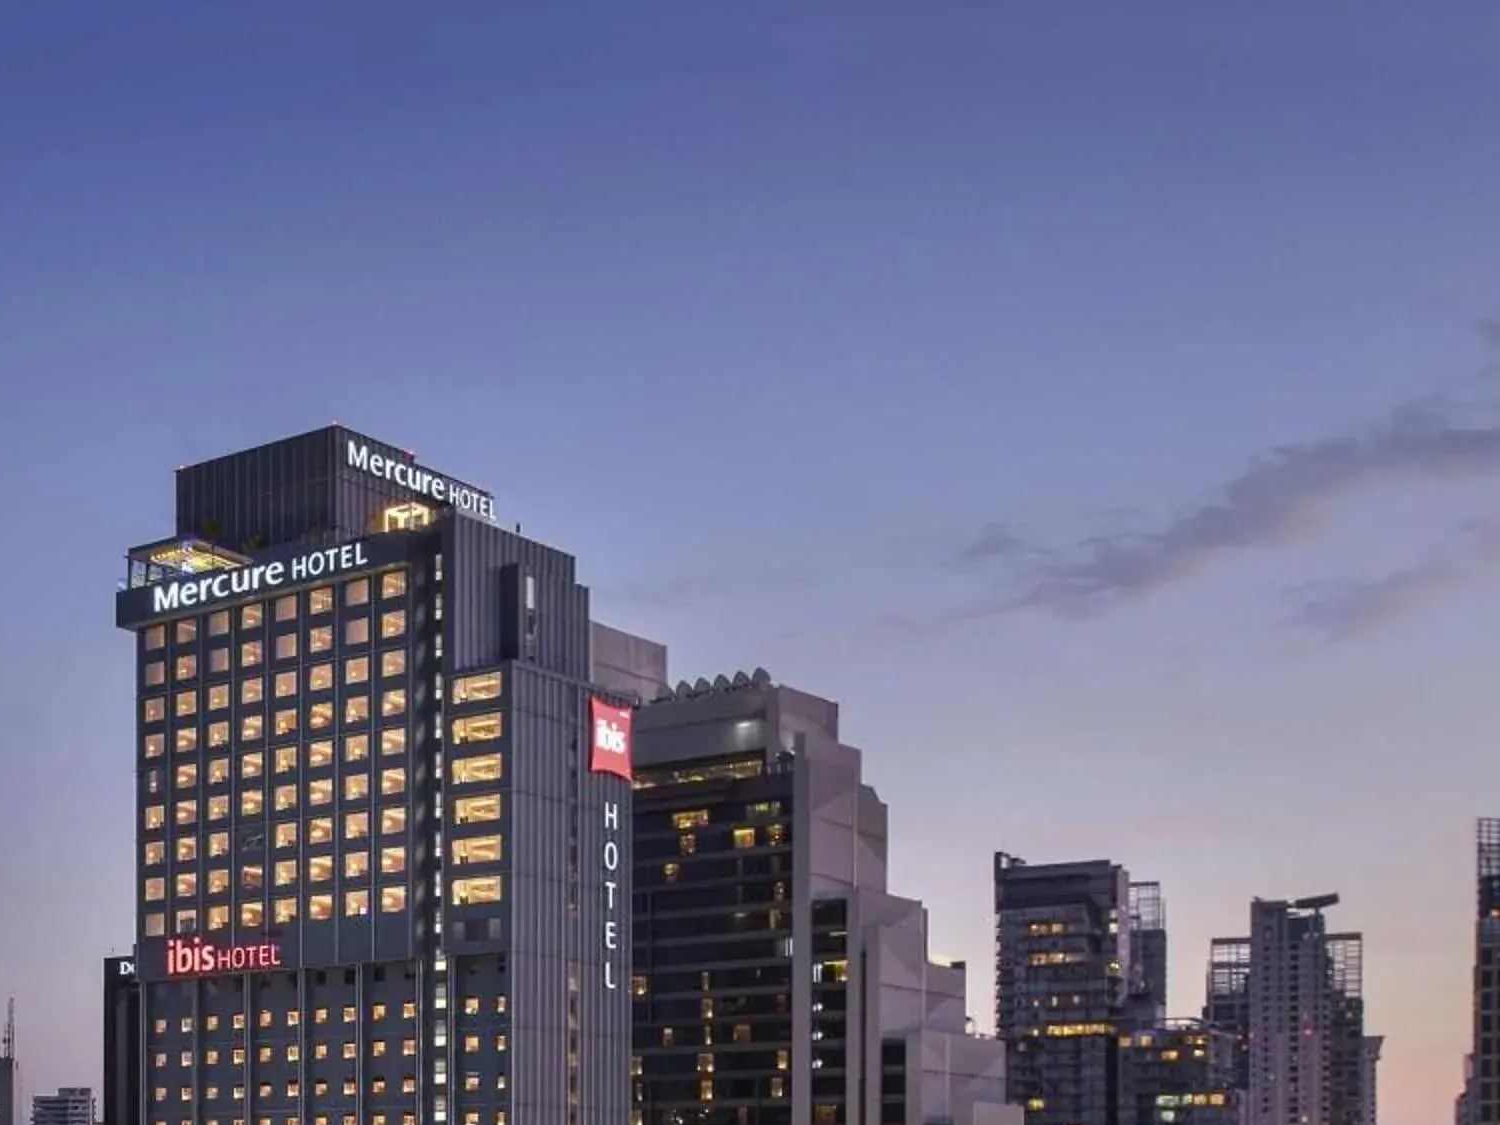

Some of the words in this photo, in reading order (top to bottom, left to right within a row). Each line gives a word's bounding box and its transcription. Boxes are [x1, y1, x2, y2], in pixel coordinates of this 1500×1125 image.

[347, 439, 445, 499] Mercure
[449, 483, 497, 521] HOTEL
[153, 560, 285, 612] Mercure
[291, 541, 368, 580] HOTEL
[596, 718, 625, 753] ibis
[604, 801, 618, 989] HOTEL
[167, 936, 214, 974] ibis
[217, 944, 281, 971] HOTEL
